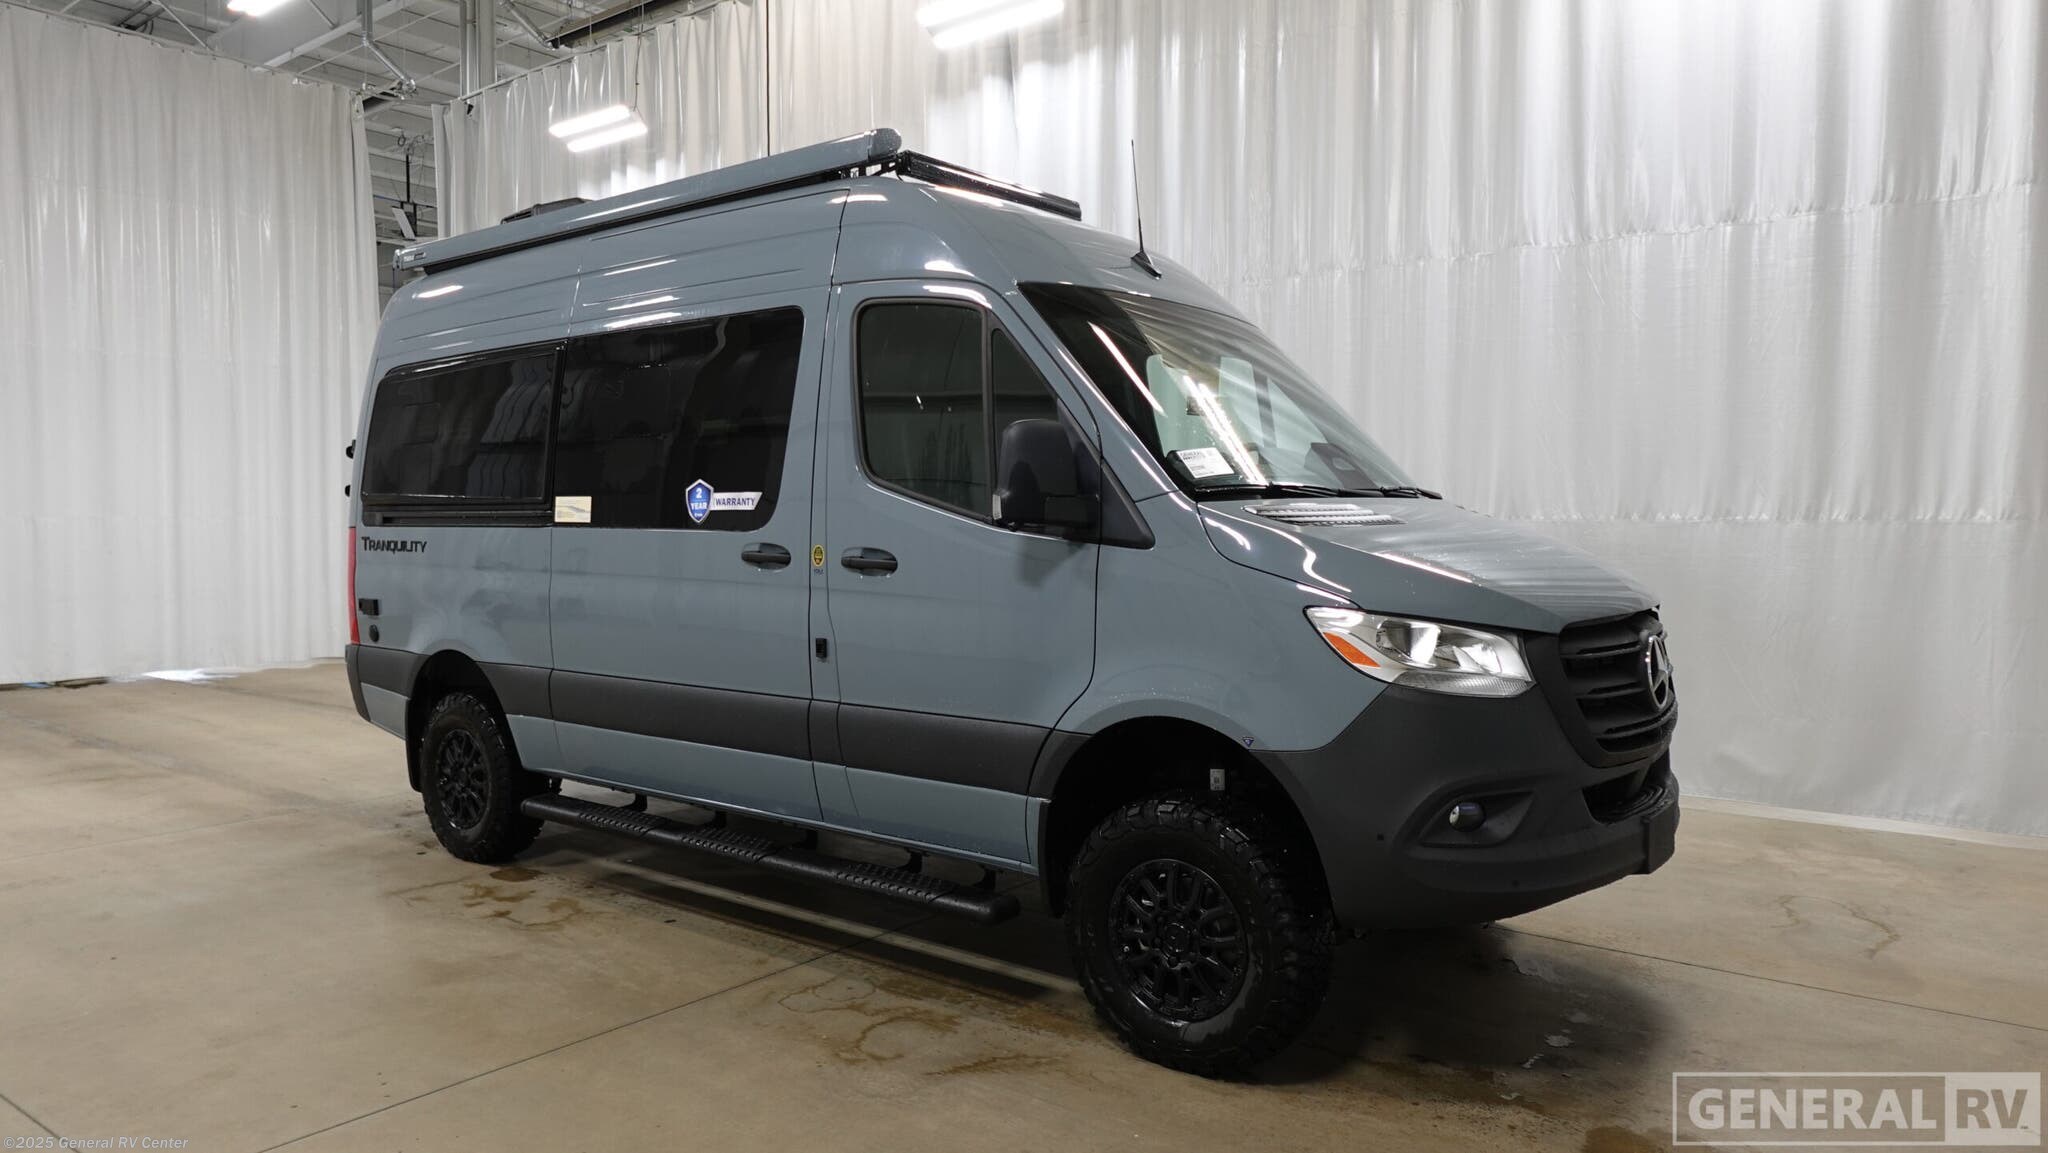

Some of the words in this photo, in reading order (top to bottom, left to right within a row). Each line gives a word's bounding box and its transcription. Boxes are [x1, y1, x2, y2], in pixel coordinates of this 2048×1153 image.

[695, 487, 703, 499] 2
[690, 502, 708, 510] YEAR
[715, 497, 756, 506] WARRANTY
[361, 536, 428, 555] TRANQUILITY
